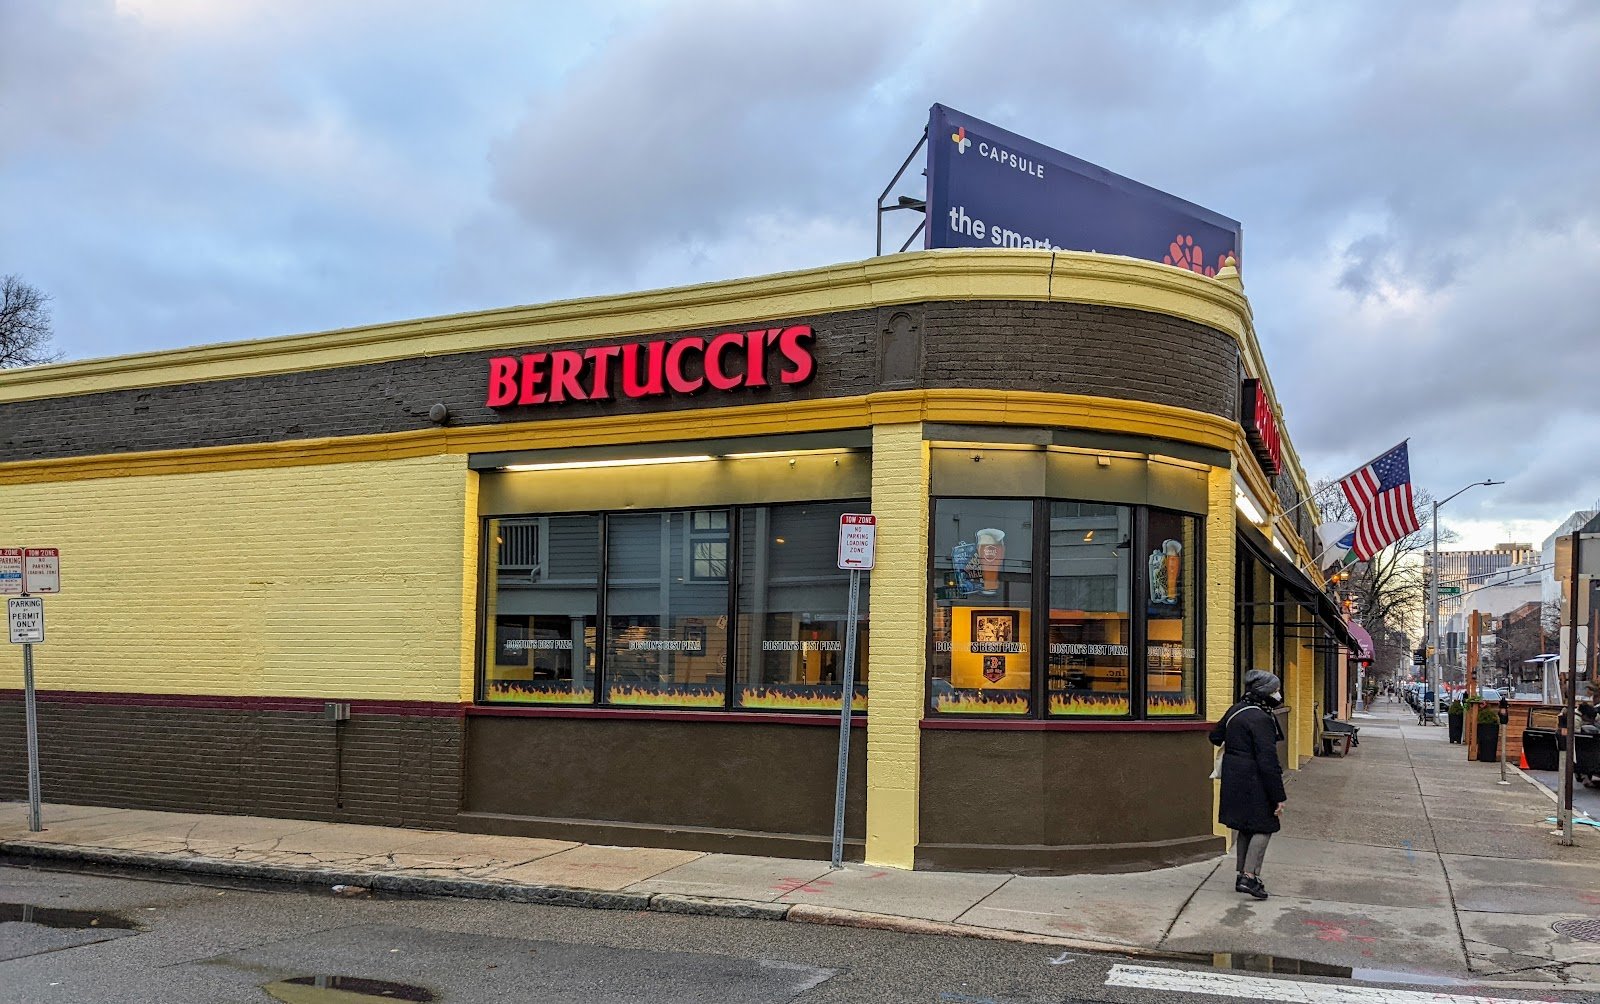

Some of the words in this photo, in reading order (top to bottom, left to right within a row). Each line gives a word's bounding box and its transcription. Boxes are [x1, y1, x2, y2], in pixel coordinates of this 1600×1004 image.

[979, 142, 1044, 178] CAPSULE
[950, 206, 986, 239] the
[991, 225, 1062, 251] smart
[486, 325, 813, 408] BERTUCCI'S
[10, 600, 41, 608] PARKING
[12, 612, 40, 620] PERMIT
[16, 620, 36, 628] ONLY
[820, 640, 842, 651] PIZZA
[979, 641, 1003, 653] BEST
[1087, 644, 1108, 656] BEST
[1107, 645, 1129, 656] PIZZA
